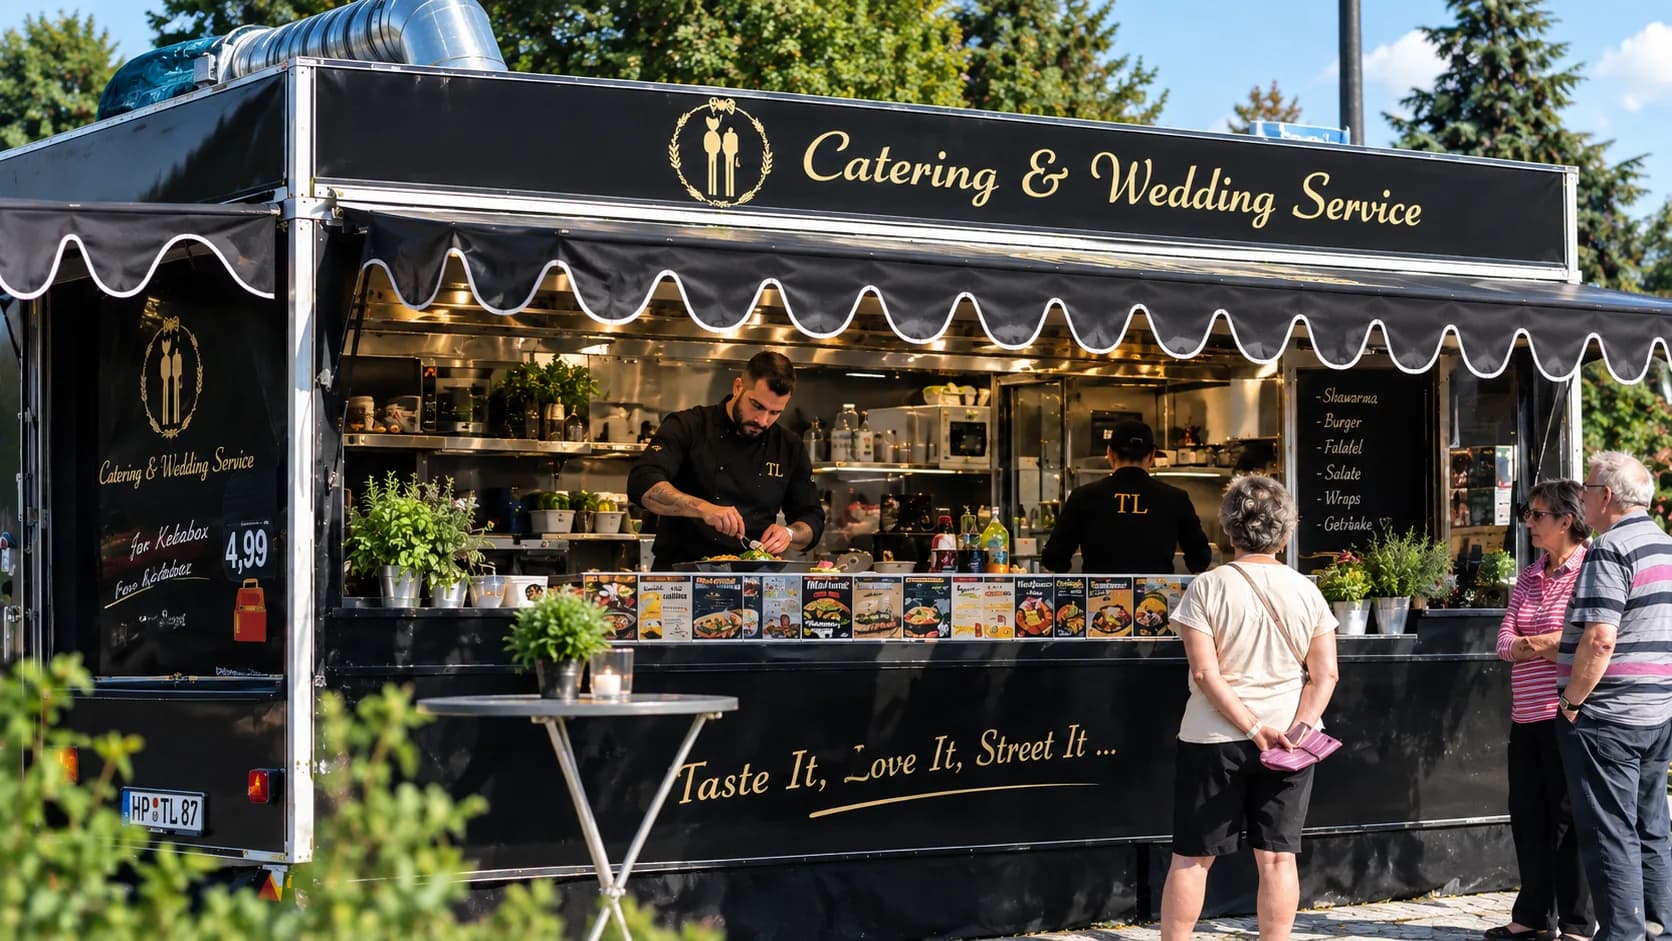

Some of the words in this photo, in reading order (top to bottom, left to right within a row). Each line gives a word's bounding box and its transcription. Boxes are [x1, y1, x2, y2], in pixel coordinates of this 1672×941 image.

[802, 129, 997, 208] Catering
[1021, 148, 1070, 199] &
[1090, 151, 1276, 229] Wedding
[1292, 171, 1422, 227] Service
[1323, 412, 1363, 433] Burger
[99, 459, 142, 489] Catering
[145, 456, 158, 480] &
[160, 451, 208, 481] Wedding
[212, 446, 254, 472] Service
[765, 461, 784, 478] TL
[1324, 463, 1361, 481] Salate
[1114, 493, 1148, 514] TL
[225, 528, 268, 575] 4,99
[676, 760, 770, 805] Taste
[785, 749, 827, 792] It,
[928, 735, 962, 774] It,
[975, 728, 1054, 767] Street
[1062, 723, 1088, 759] It
[131, 795, 150, 822] HP
[161, 797, 178, 825] TL
[181, 798, 199, 827] 87
